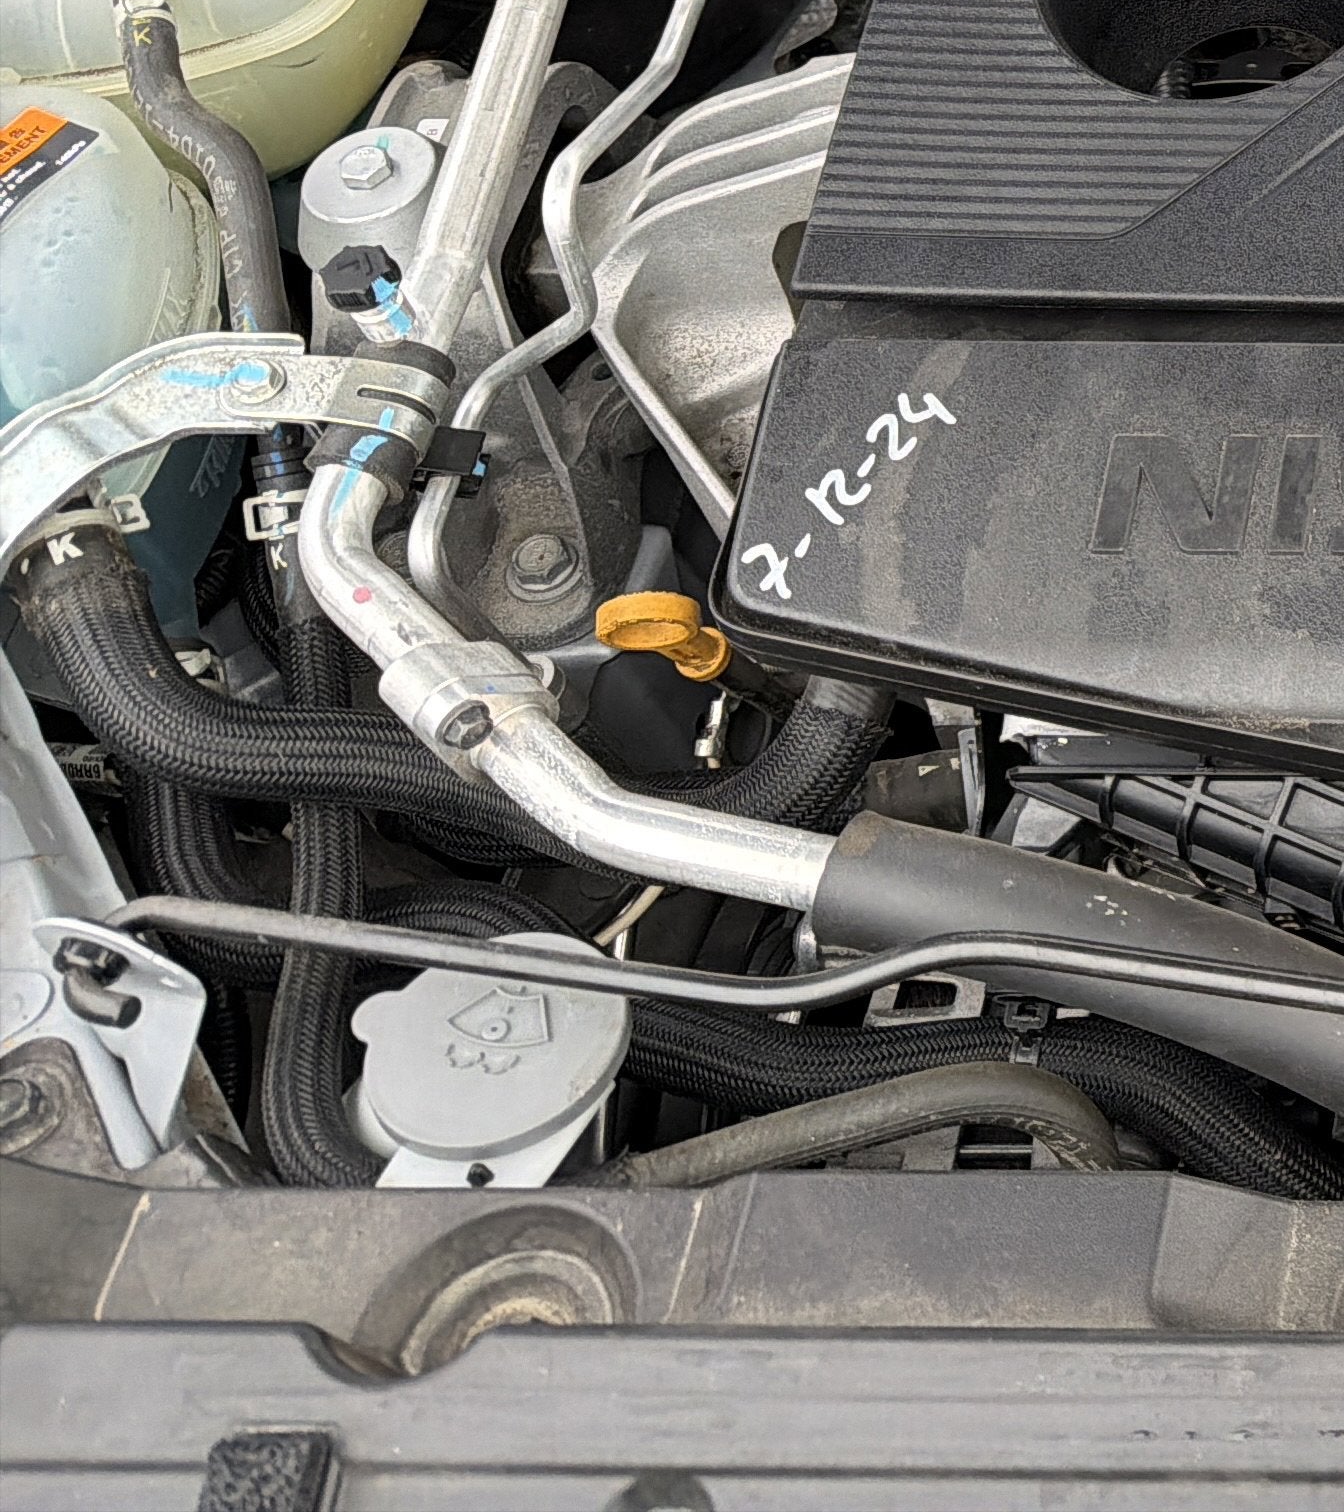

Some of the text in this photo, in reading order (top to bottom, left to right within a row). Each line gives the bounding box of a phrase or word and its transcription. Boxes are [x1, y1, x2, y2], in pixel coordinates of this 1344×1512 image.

[133, 27, 152, 46] K
[47, 532, 83, 565] K
[271, 543, 288, 570] K
